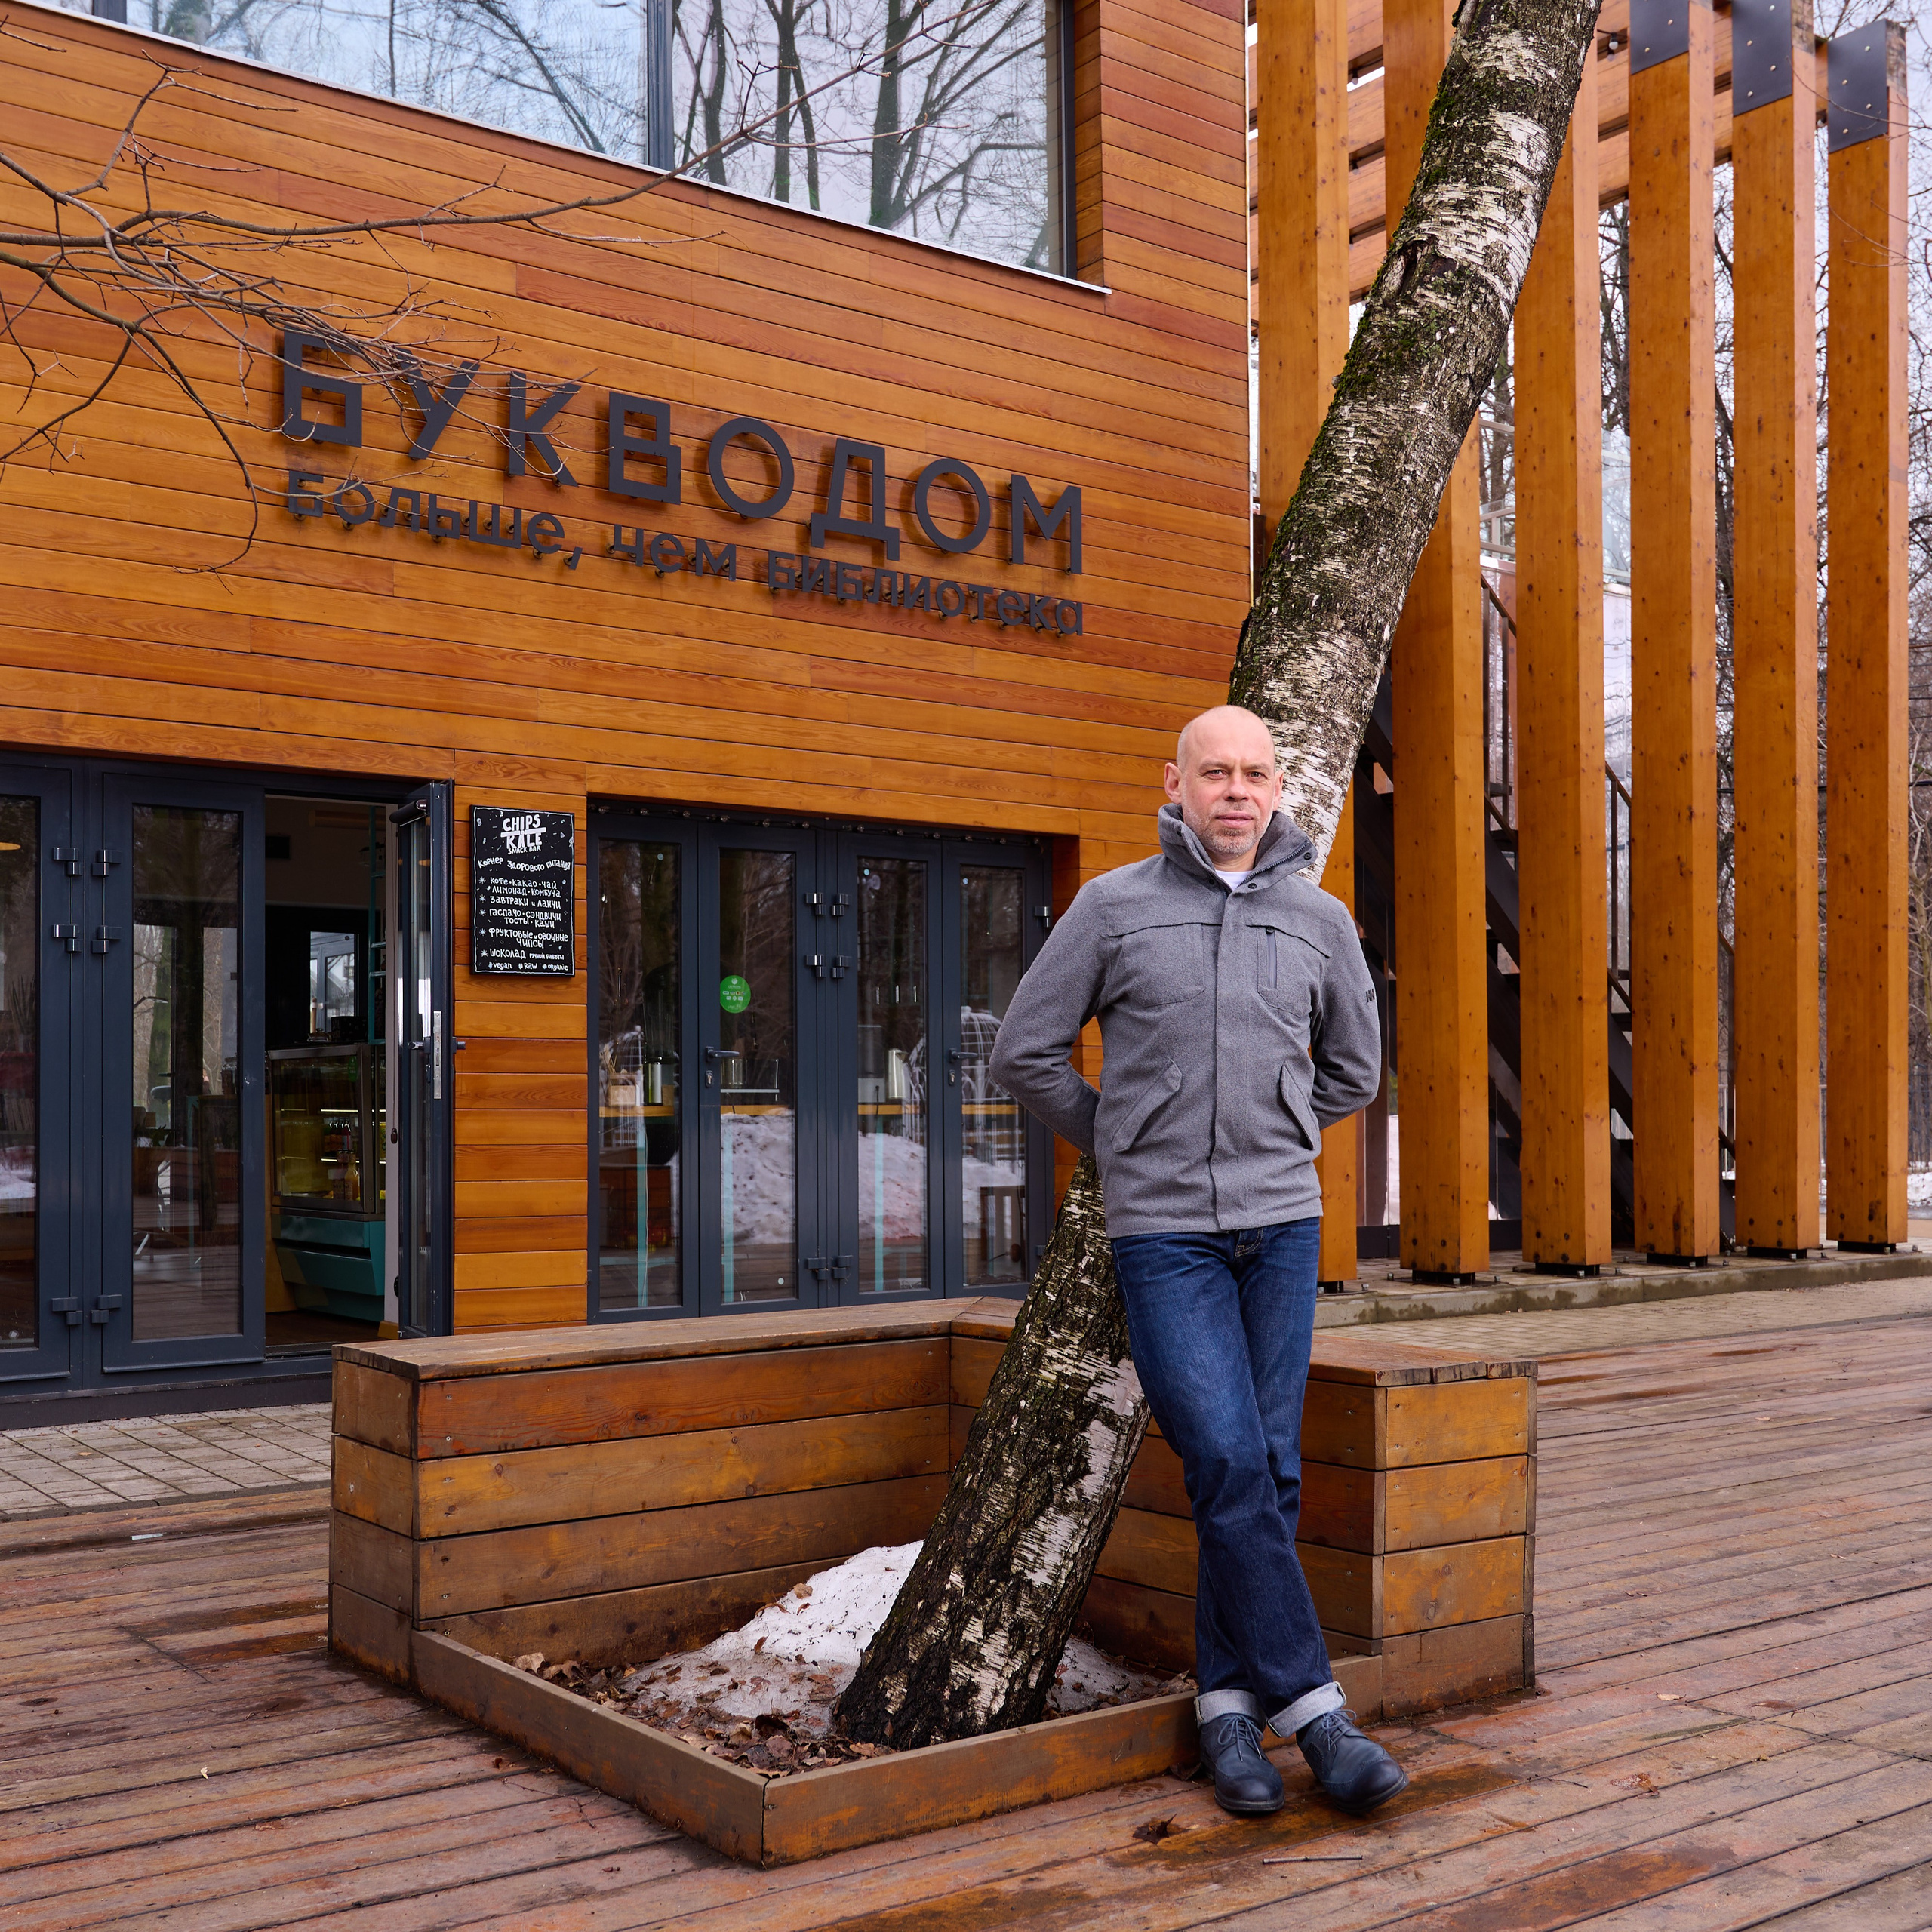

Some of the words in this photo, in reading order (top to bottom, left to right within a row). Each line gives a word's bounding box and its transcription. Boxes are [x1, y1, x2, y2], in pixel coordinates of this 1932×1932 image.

[284, 325, 1082, 574] БУКВОДОМ
[614, 524, 737, 581] чем
[503, 814, 541, 832] CHIPS
[506, 832, 543, 849] KALE
[507, 847, 528, 855] SNACK
